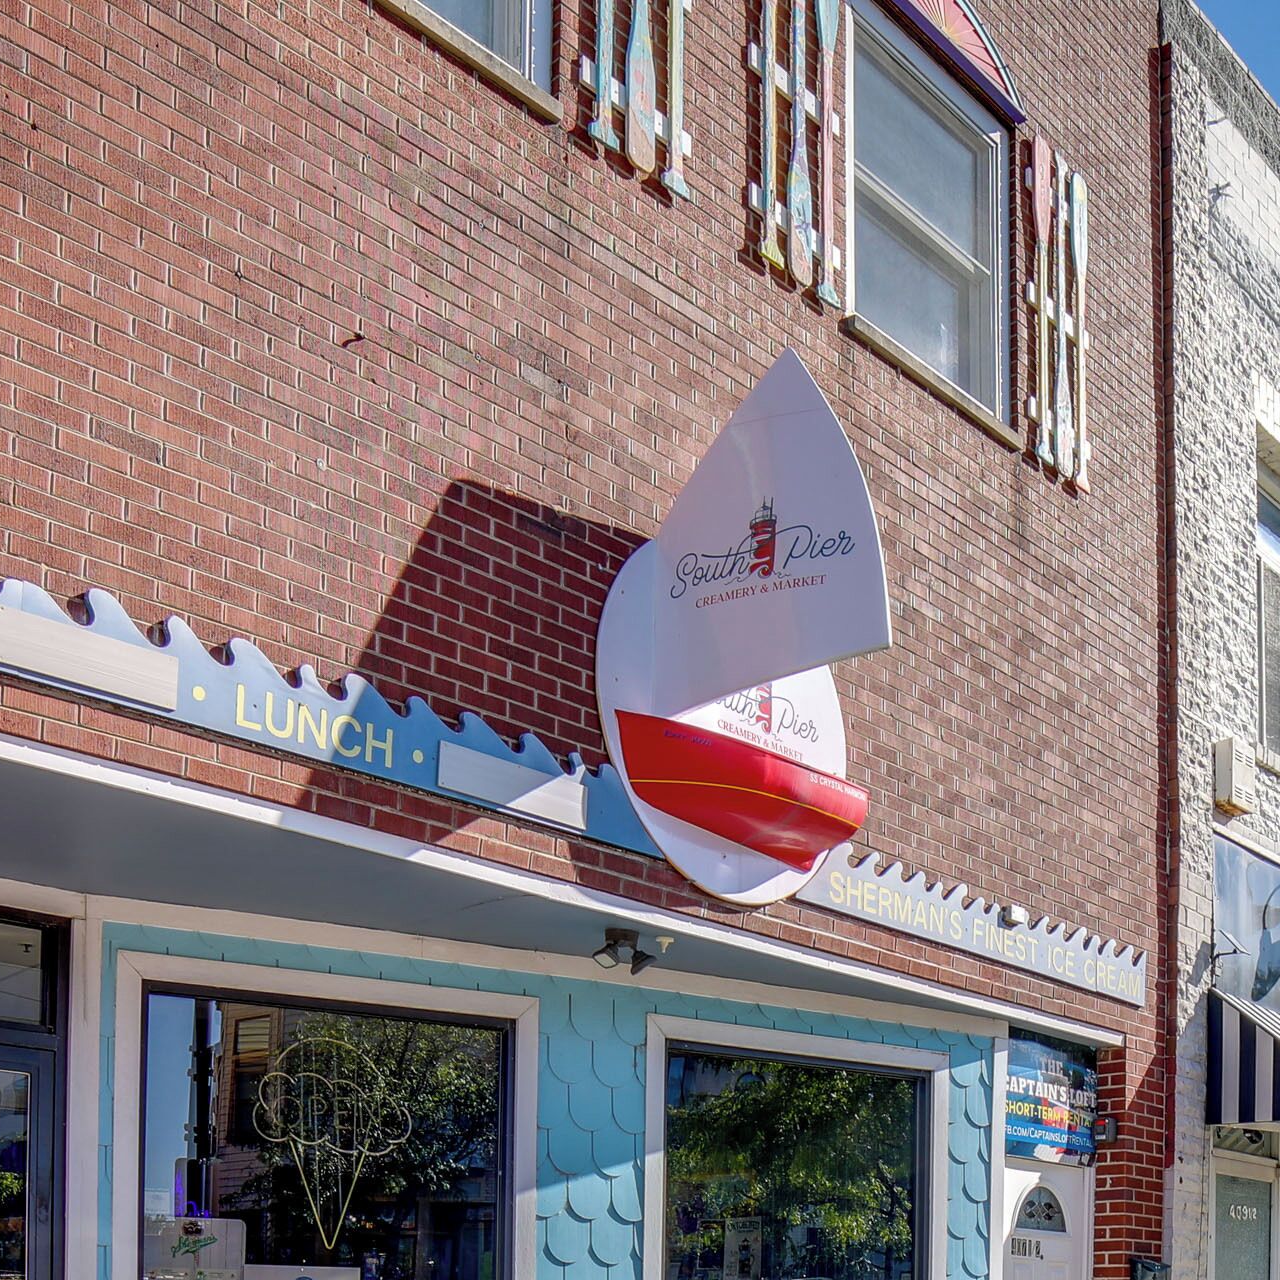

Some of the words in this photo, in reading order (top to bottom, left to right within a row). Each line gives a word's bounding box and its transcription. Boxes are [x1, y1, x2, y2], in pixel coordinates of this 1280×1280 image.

[670, 534, 758, 599] South
[774, 525, 856, 570] Pier
[695, 586, 757, 609] CREAMERY
[760, 583, 769, 593] &
[772, 574, 827, 592] MARKET
[235, 683, 394, 769] LUNCH
[717, 718, 762, 745] CREAMERY
[763, 737, 770, 748] &
[771, 741, 804, 762] MARKET
[772, 697, 819, 743] Pier
[829, 871, 962, 941] SHERMAN'S
[973, 918, 1039, 965] FINEST
[1047, 944, 1077, 978] ICE
[1083, 958, 1141, 999] CREAM
[1040, 1057, 1064, 1077] THE
[272, 1094, 382, 1131] OPEN
[1069, 1087, 1097, 1108] LOFT
